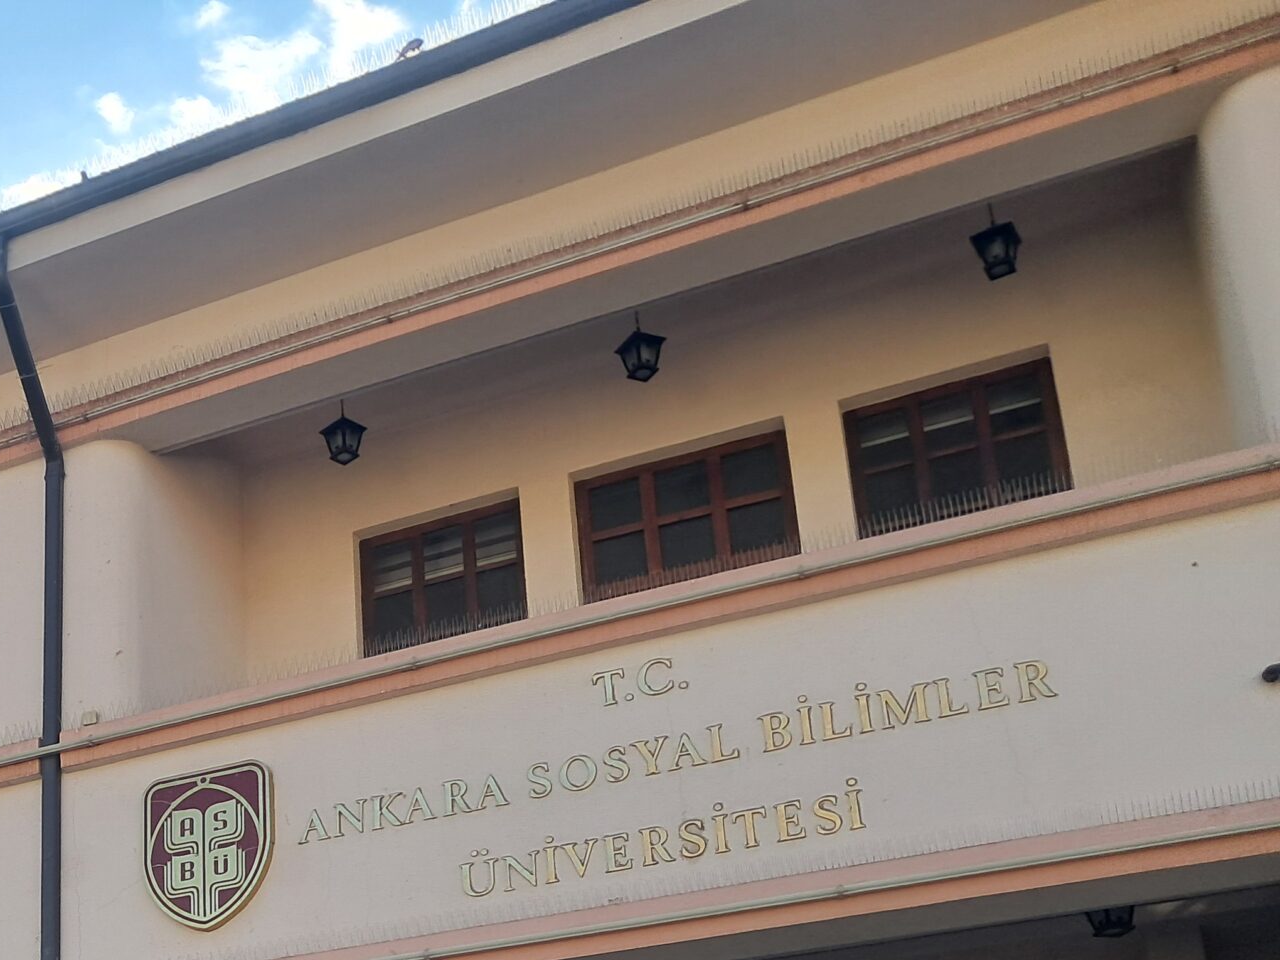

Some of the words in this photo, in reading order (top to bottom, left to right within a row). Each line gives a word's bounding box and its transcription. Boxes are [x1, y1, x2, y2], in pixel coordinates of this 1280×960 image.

[591, 657, 689, 707] T.C.
[298, 774, 509, 845] ANKARA
[527, 723, 740, 799] SOSYAL
[756, 659, 1059, 754] BİLİMLER
[459, 777, 867, 898] ÜNİVERSİTESİ
